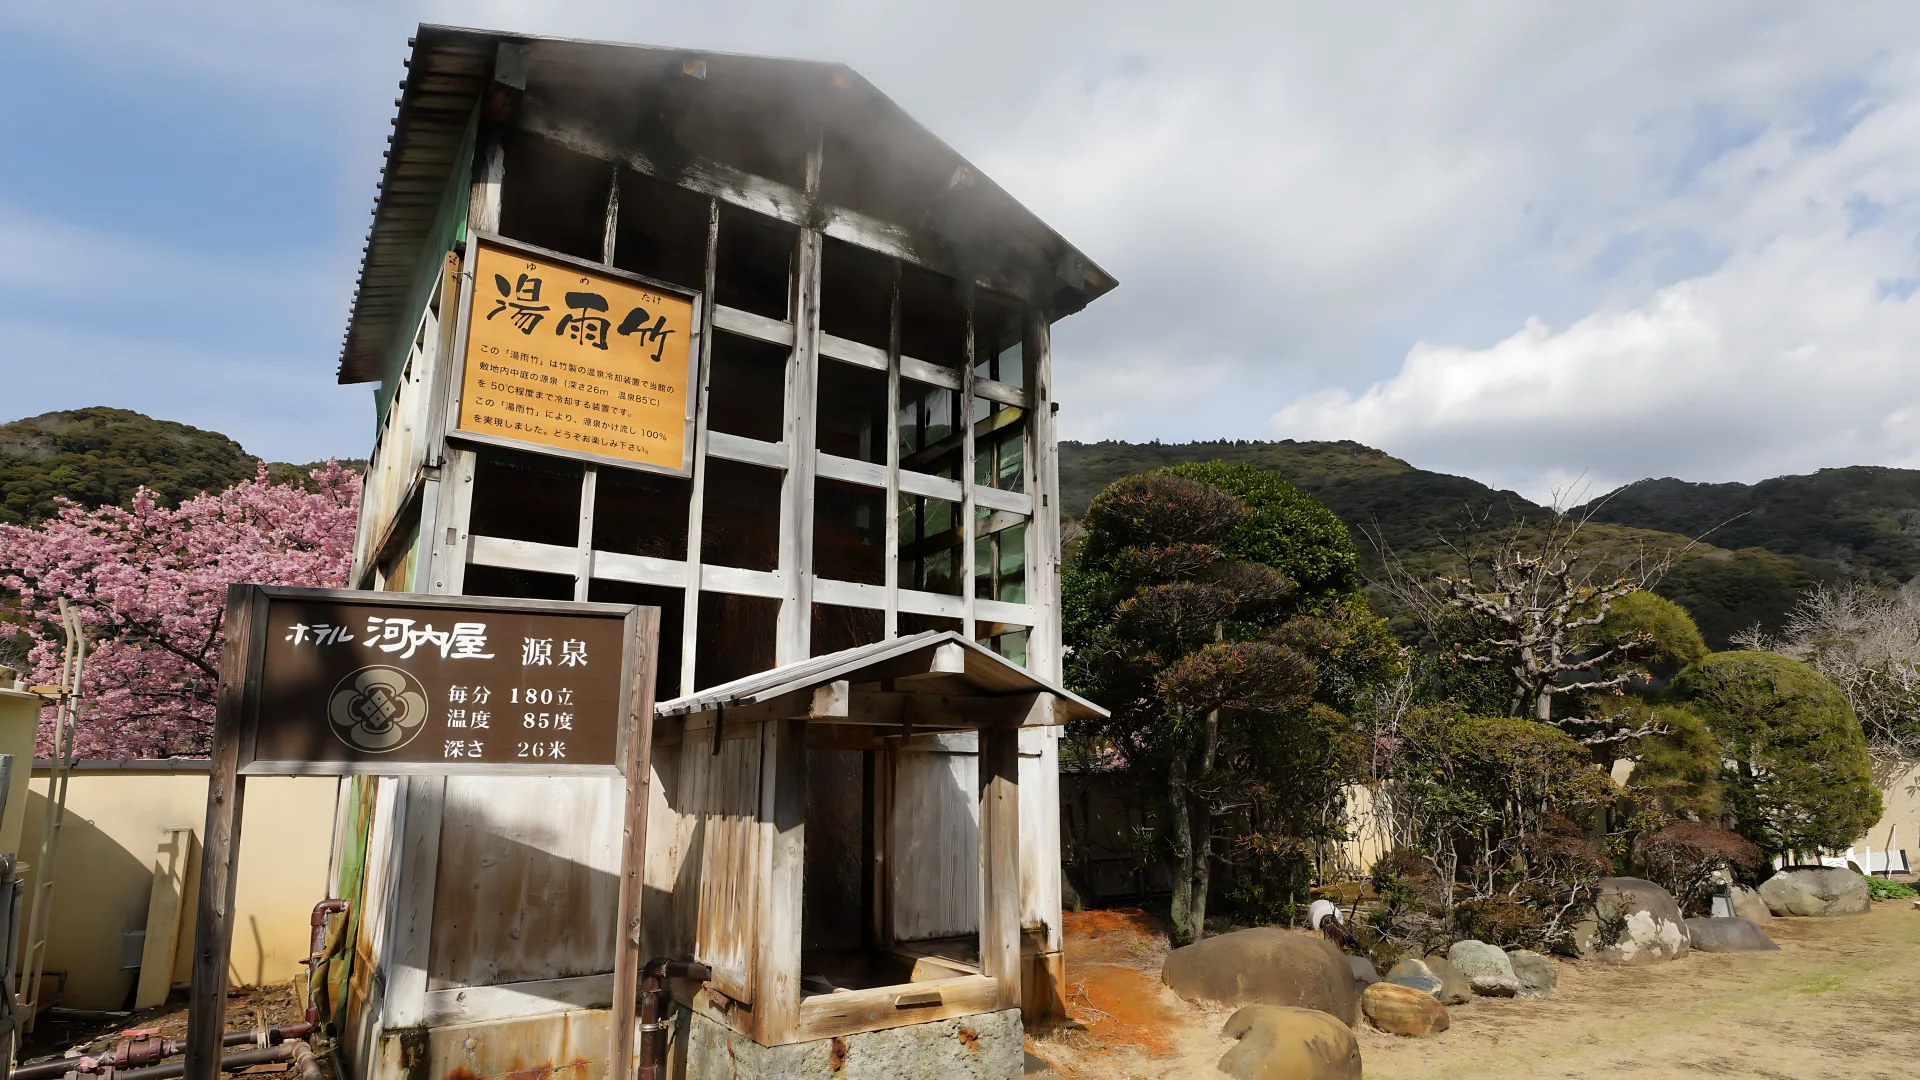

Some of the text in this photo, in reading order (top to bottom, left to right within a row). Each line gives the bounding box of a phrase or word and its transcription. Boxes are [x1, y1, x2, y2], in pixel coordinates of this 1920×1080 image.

[487, 273, 675, 362] 湯雨竹
[285, 617, 588, 667] ホテル 河内屋 源泉
[448, 685, 574, 706] 毎分 180立
[447, 709, 574, 731] 温度 85度
[444, 740, 566, 759] 深さ 26米
